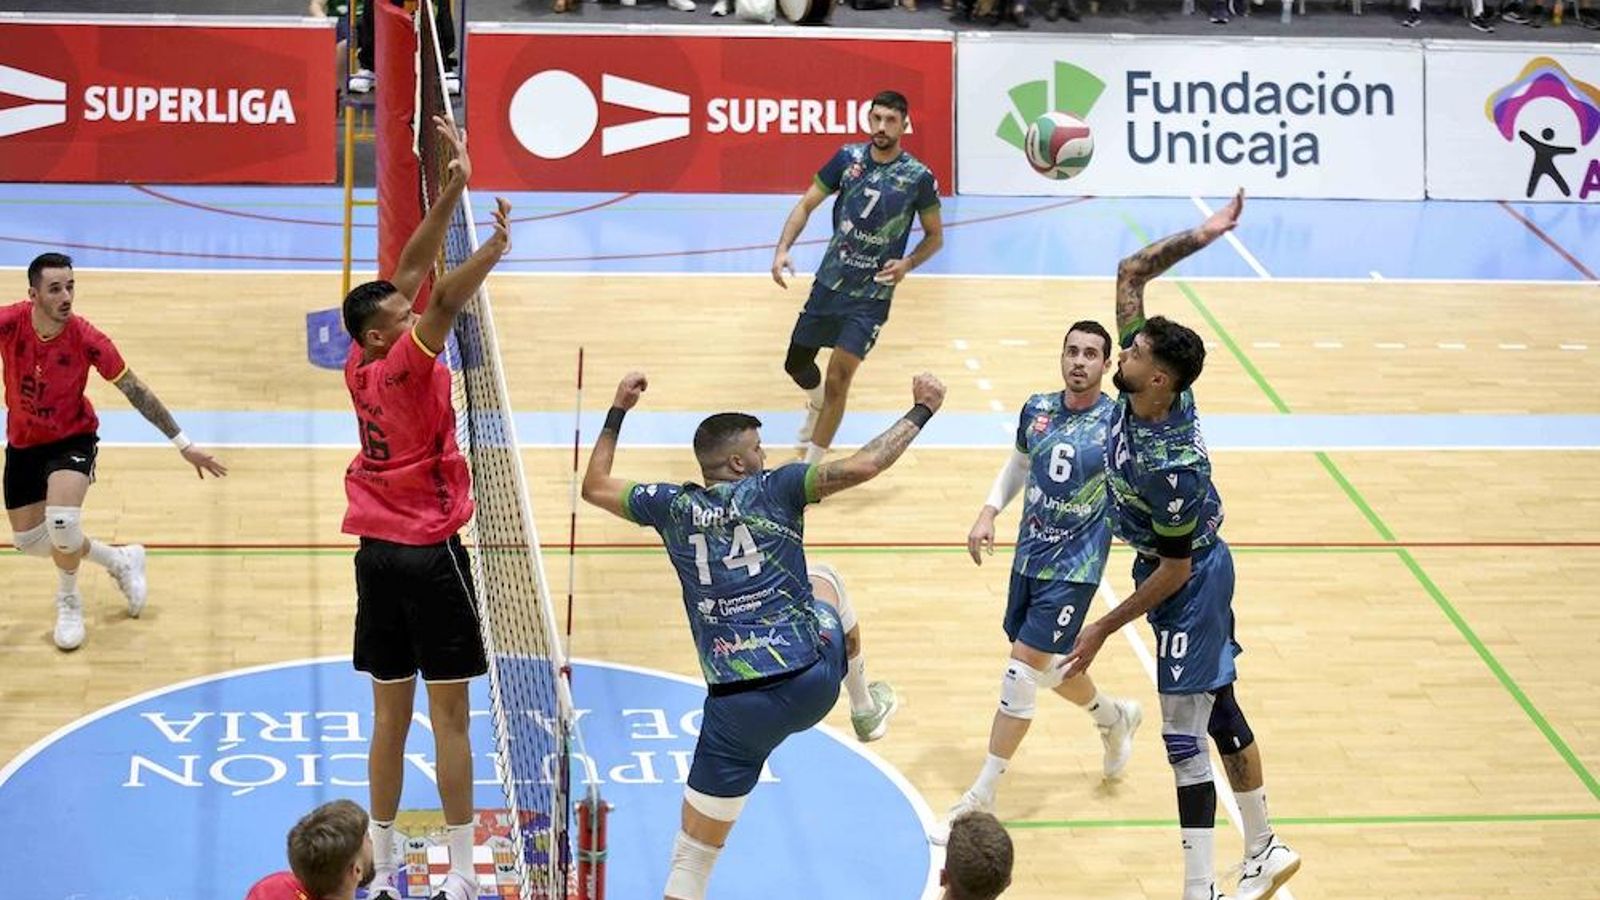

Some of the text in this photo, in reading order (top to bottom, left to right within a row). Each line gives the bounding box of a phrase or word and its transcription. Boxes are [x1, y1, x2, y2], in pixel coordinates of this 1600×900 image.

[83, 85, 297, 125] SUPERLIGA
[1125, 70, 1395, 116] Fundación
[1126, 119, 1321, 179] Unicaja
[860, 187, 881, 220] 7
[1048, 441, 1076, 484] 6
[688, 523, 765, 586] 14
[1056, 604, 1076, 627] 6
[1158, 630, 1189, 660] 10
